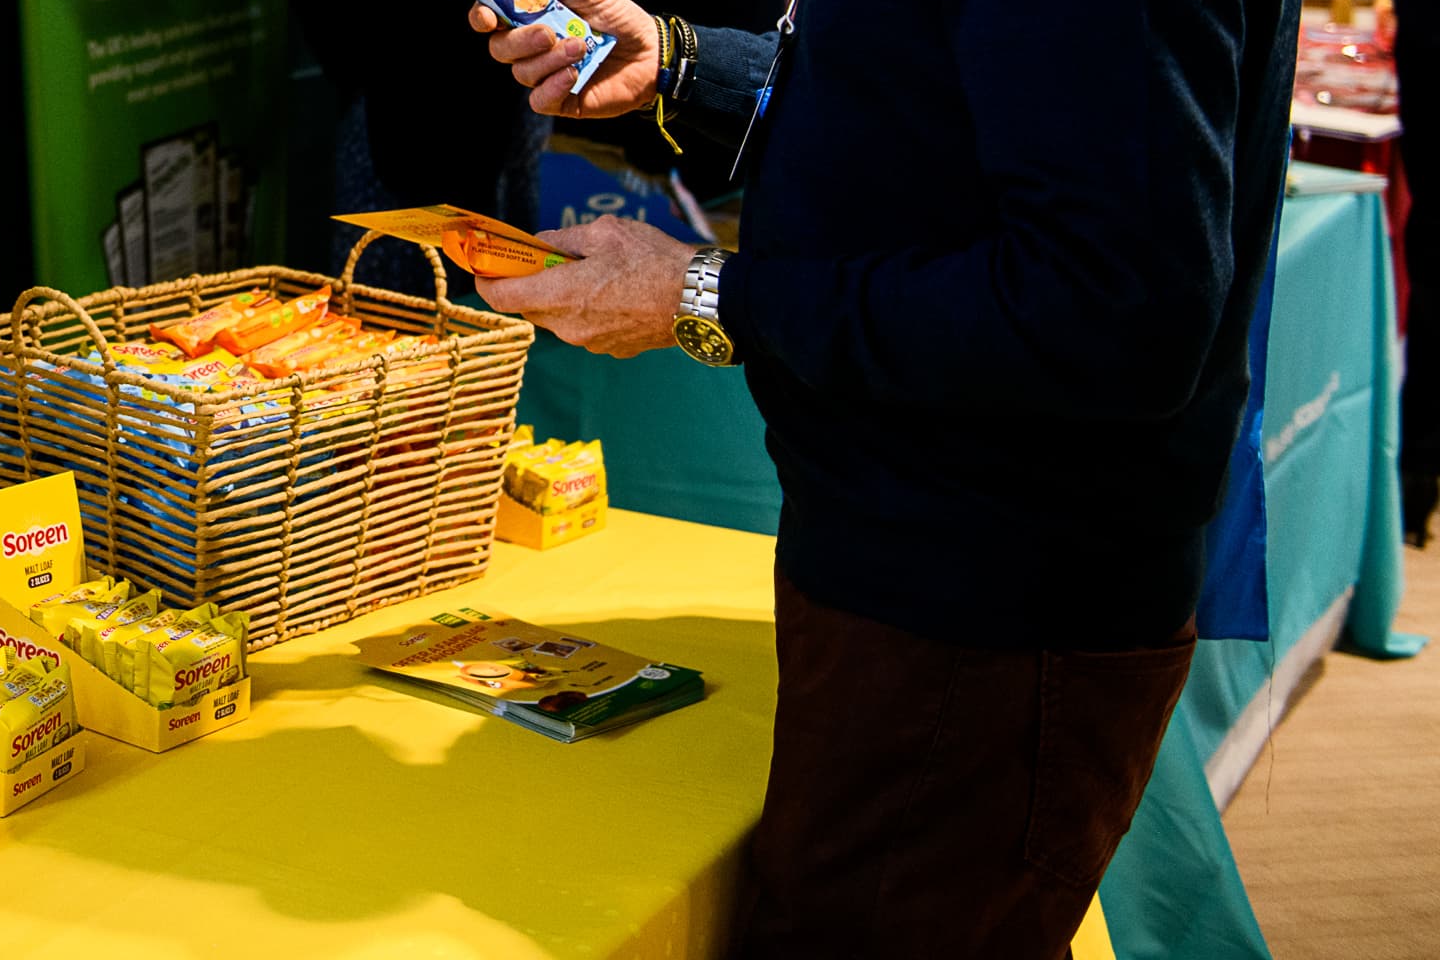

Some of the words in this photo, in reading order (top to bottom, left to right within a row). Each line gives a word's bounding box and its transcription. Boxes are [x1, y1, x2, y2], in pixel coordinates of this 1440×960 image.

[471, 246, 505, 258] FLAVOURED
[505, 252, 520, 262] SOFT
[521, 256, 537, 265] BAKE
[508, 246, 534, 257] BANANA
[551, 473, 597, 497] Soreen
[2, 523, 68, 557] Soreen
[24, 563, 39, 576] MALT
[40, 559, 53, 572] LOAF
[30, 578, 35, 587] 2
[34, 574, 51, 586] SLICES
[174, 653, 231, 692] Soreen
[213, 695, 227, 708] MALT
[168, 711, 201, 732] Soreen
[11, 711, 62, 758] Soreen
[13, 772, 43, 797] Soreen
